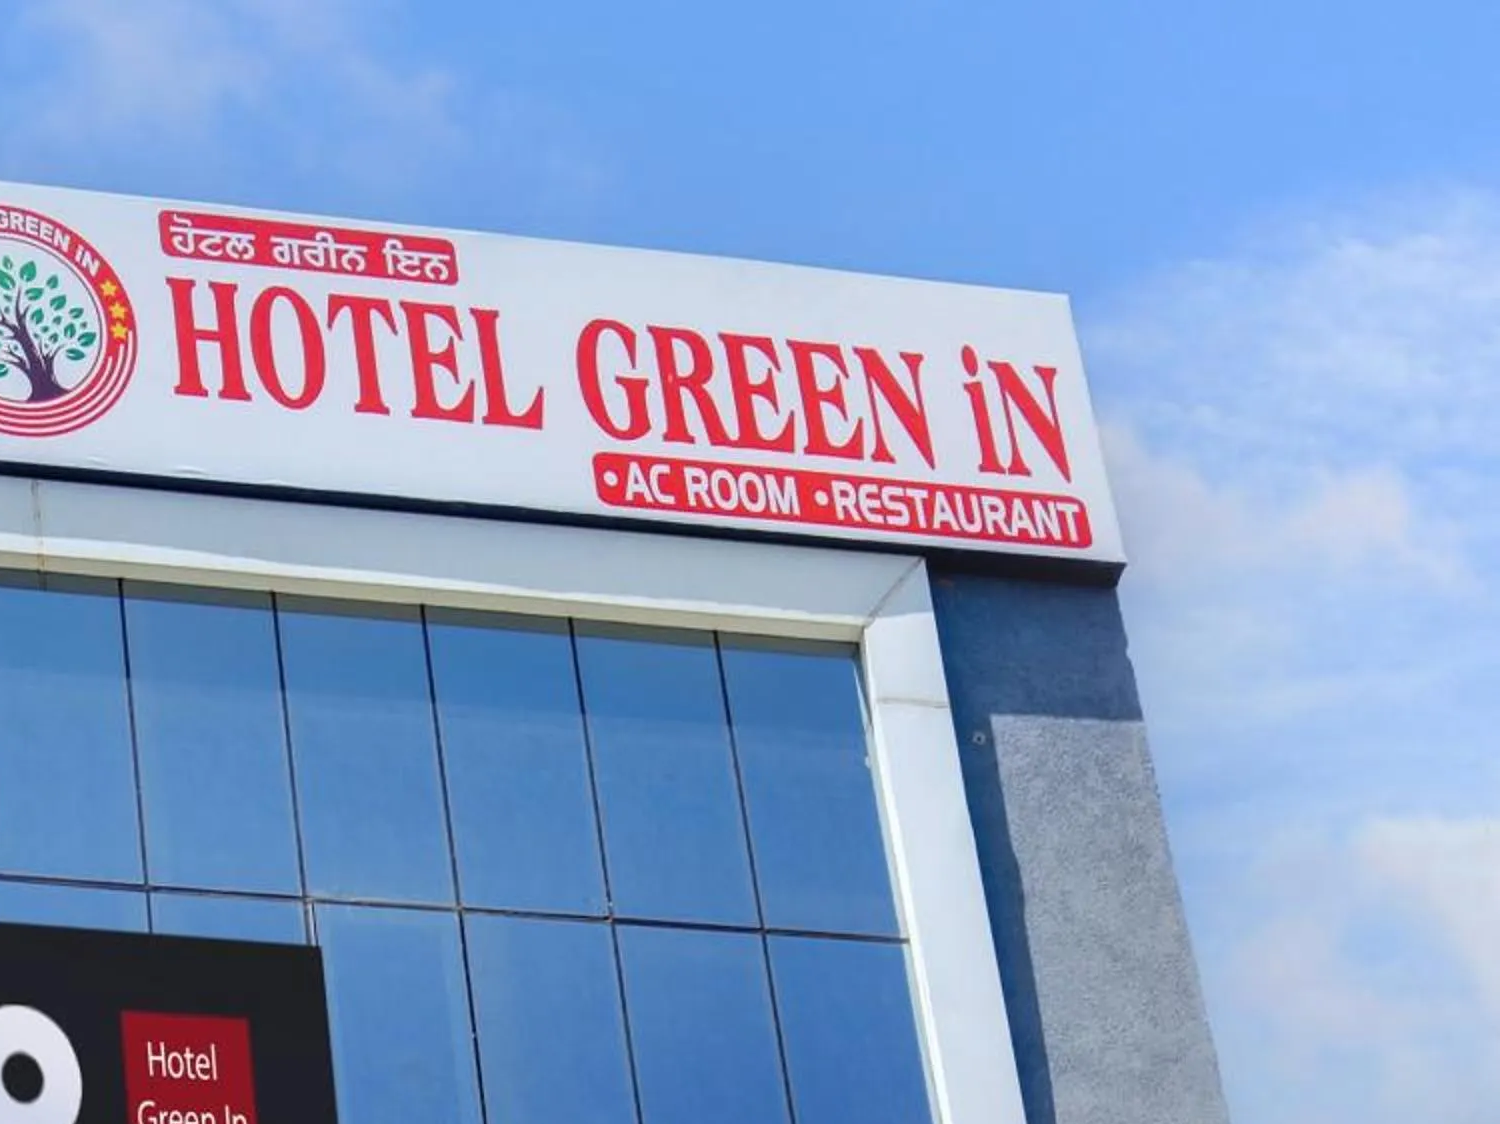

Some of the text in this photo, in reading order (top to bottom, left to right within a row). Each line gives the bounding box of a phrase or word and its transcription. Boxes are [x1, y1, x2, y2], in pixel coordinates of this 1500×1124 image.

[74, 243, 101, 277] IN
[169, 213, 256, 260] ਹੋਟਲ
[165, 276, 545, 431] HOTEL
[576, 317, 937, 471] GREEN
[624, 459, 1081, 543] AC ROOM RESTAURANT
[146, 1040, 219, 1082] Hotel
